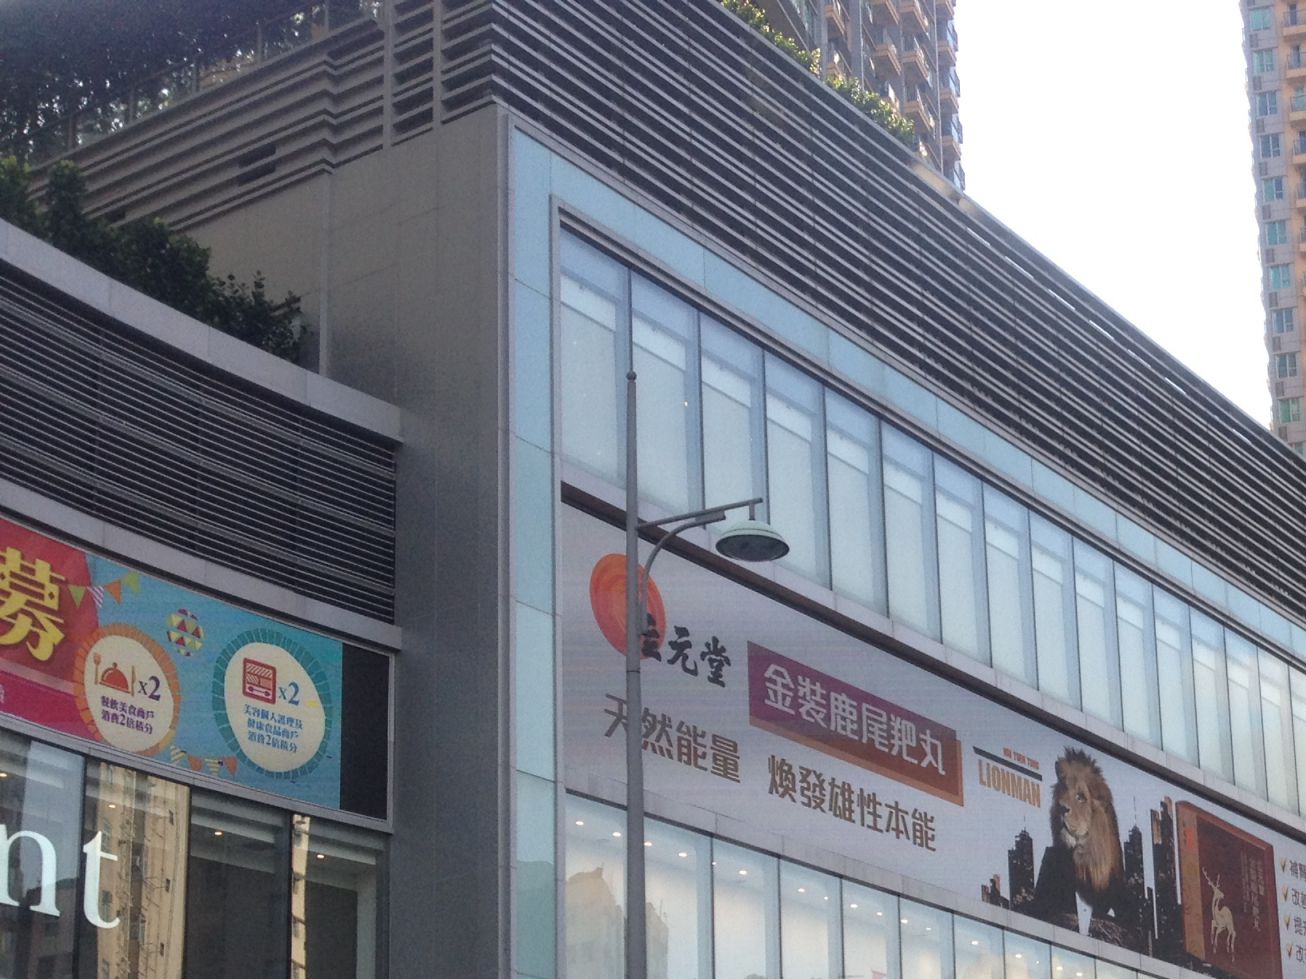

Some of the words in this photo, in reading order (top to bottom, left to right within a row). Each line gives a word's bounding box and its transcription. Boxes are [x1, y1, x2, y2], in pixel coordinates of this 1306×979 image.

[605, 693, 741, 784] 天然能量
[978, 760, 1041, 808] LIONMAN
[768, 754, 936, 852] 煥發雄性本能
